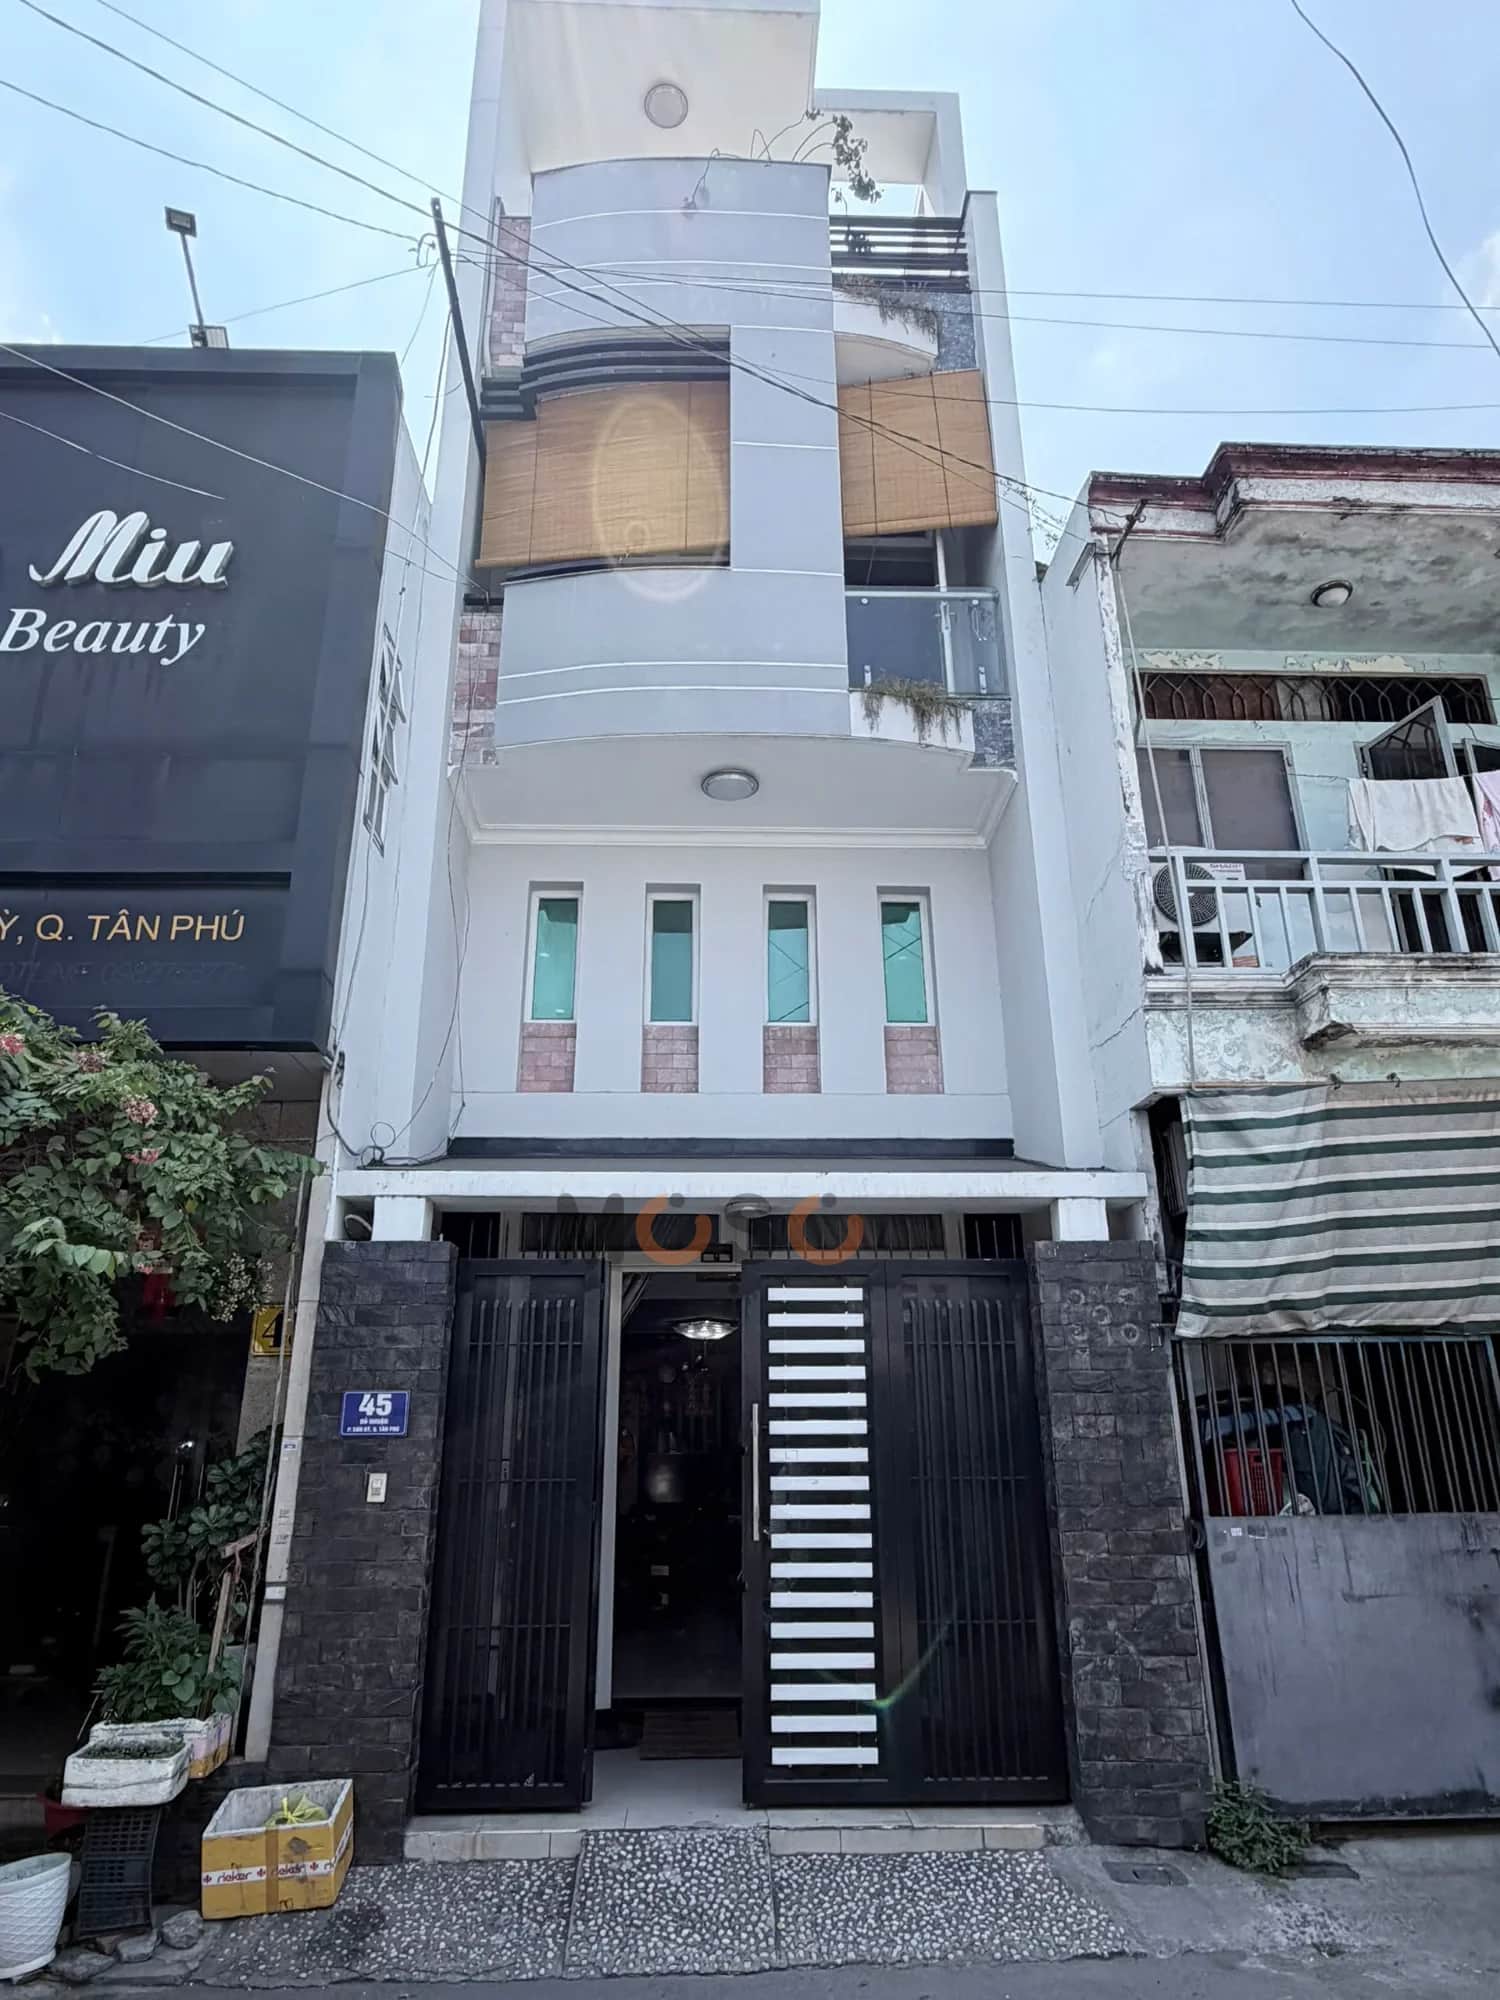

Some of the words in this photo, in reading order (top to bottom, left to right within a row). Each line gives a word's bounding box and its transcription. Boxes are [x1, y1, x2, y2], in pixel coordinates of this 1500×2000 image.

[29, 510, 234, 588] Miu
[0, 608, 206, 665] Beauty
[36, 913, 73, 941] Q.
[87, 908, 161, 941] TÂN
[169, 908, 246, 941] PHÚ
[358, 1393, 393, 1416] 45
